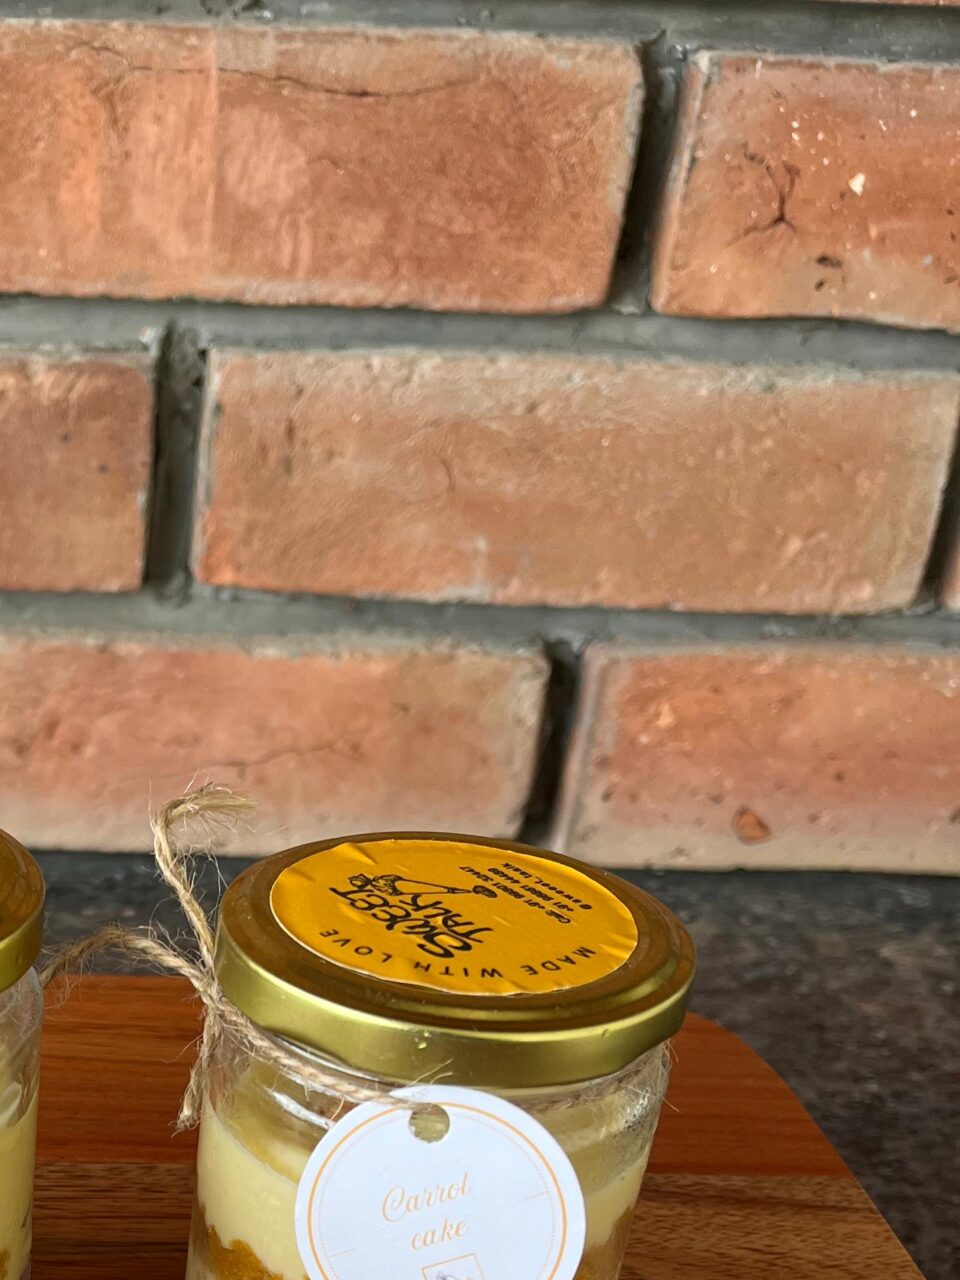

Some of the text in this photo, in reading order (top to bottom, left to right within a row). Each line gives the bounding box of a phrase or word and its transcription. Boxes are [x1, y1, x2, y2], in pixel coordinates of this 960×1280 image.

[329, 887, 473, 958] SWEET
[398, 894, 494, 943] TALK
[319, 929, 596, 979] MADE WITH LOVE
[381, 1171, 473, 1222] Carrot
[410, 1217, 470, 1250] cake
